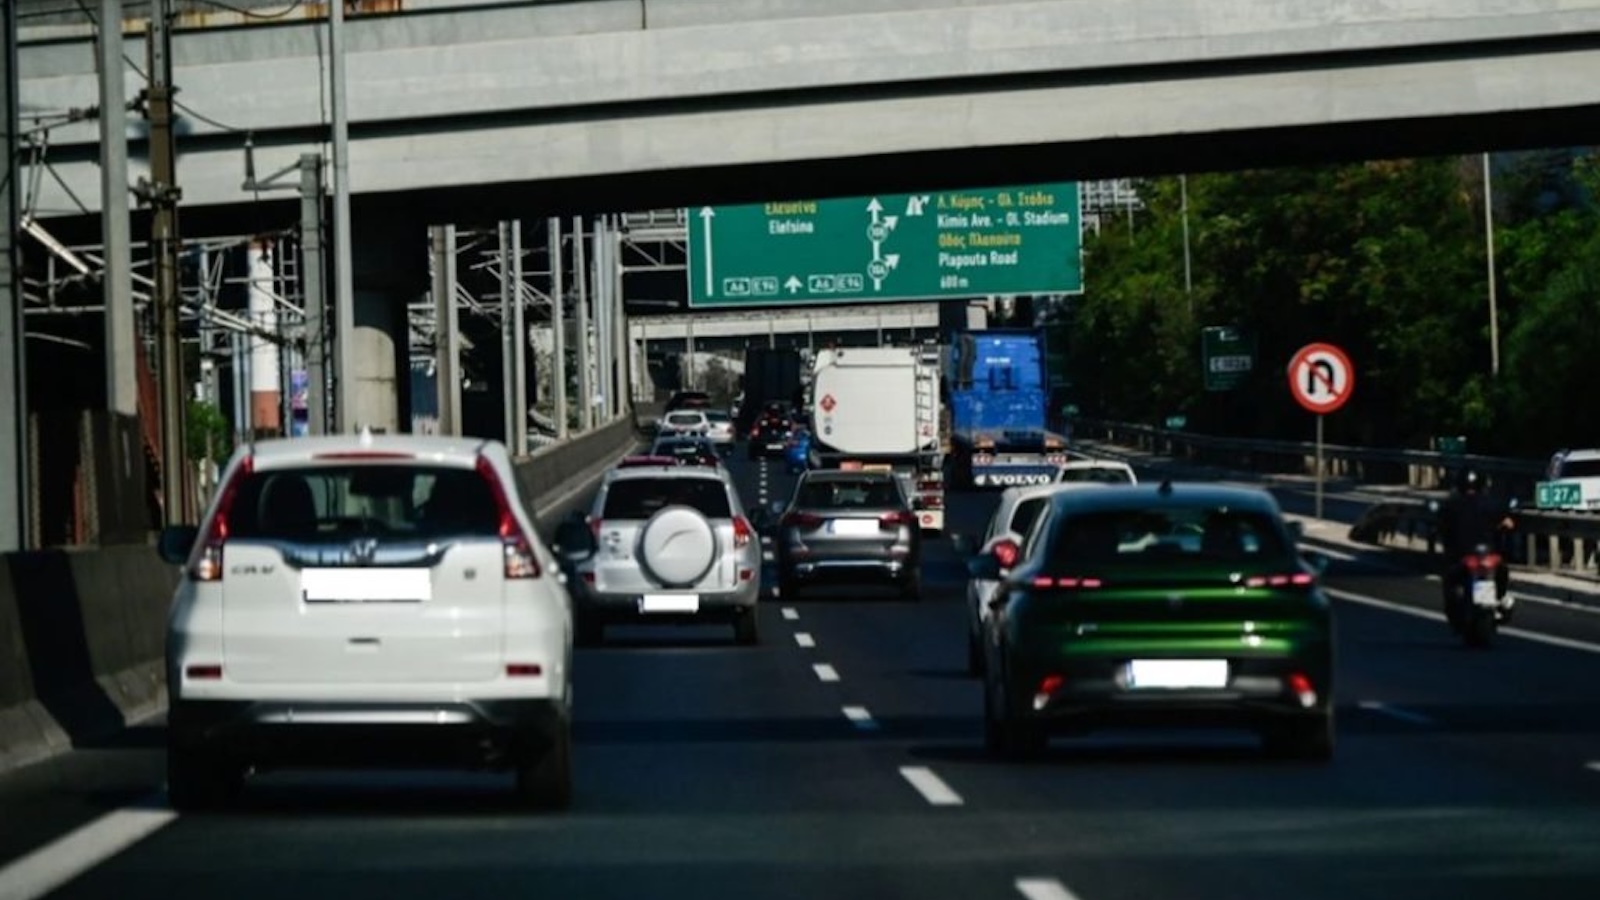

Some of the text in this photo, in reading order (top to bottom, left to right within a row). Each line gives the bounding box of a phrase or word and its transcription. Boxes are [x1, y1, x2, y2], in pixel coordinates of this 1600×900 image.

[769, 218, 813, 234] Elefsina
[937, 213, 968, 228] Kimis
[971, 212, 993, 227] Ave.
[1023, 210, 1069, 226] Stadium
[938, 249, 1018, 270] Plapouta Road
[990, 474, 1050, 486] VOLVO
